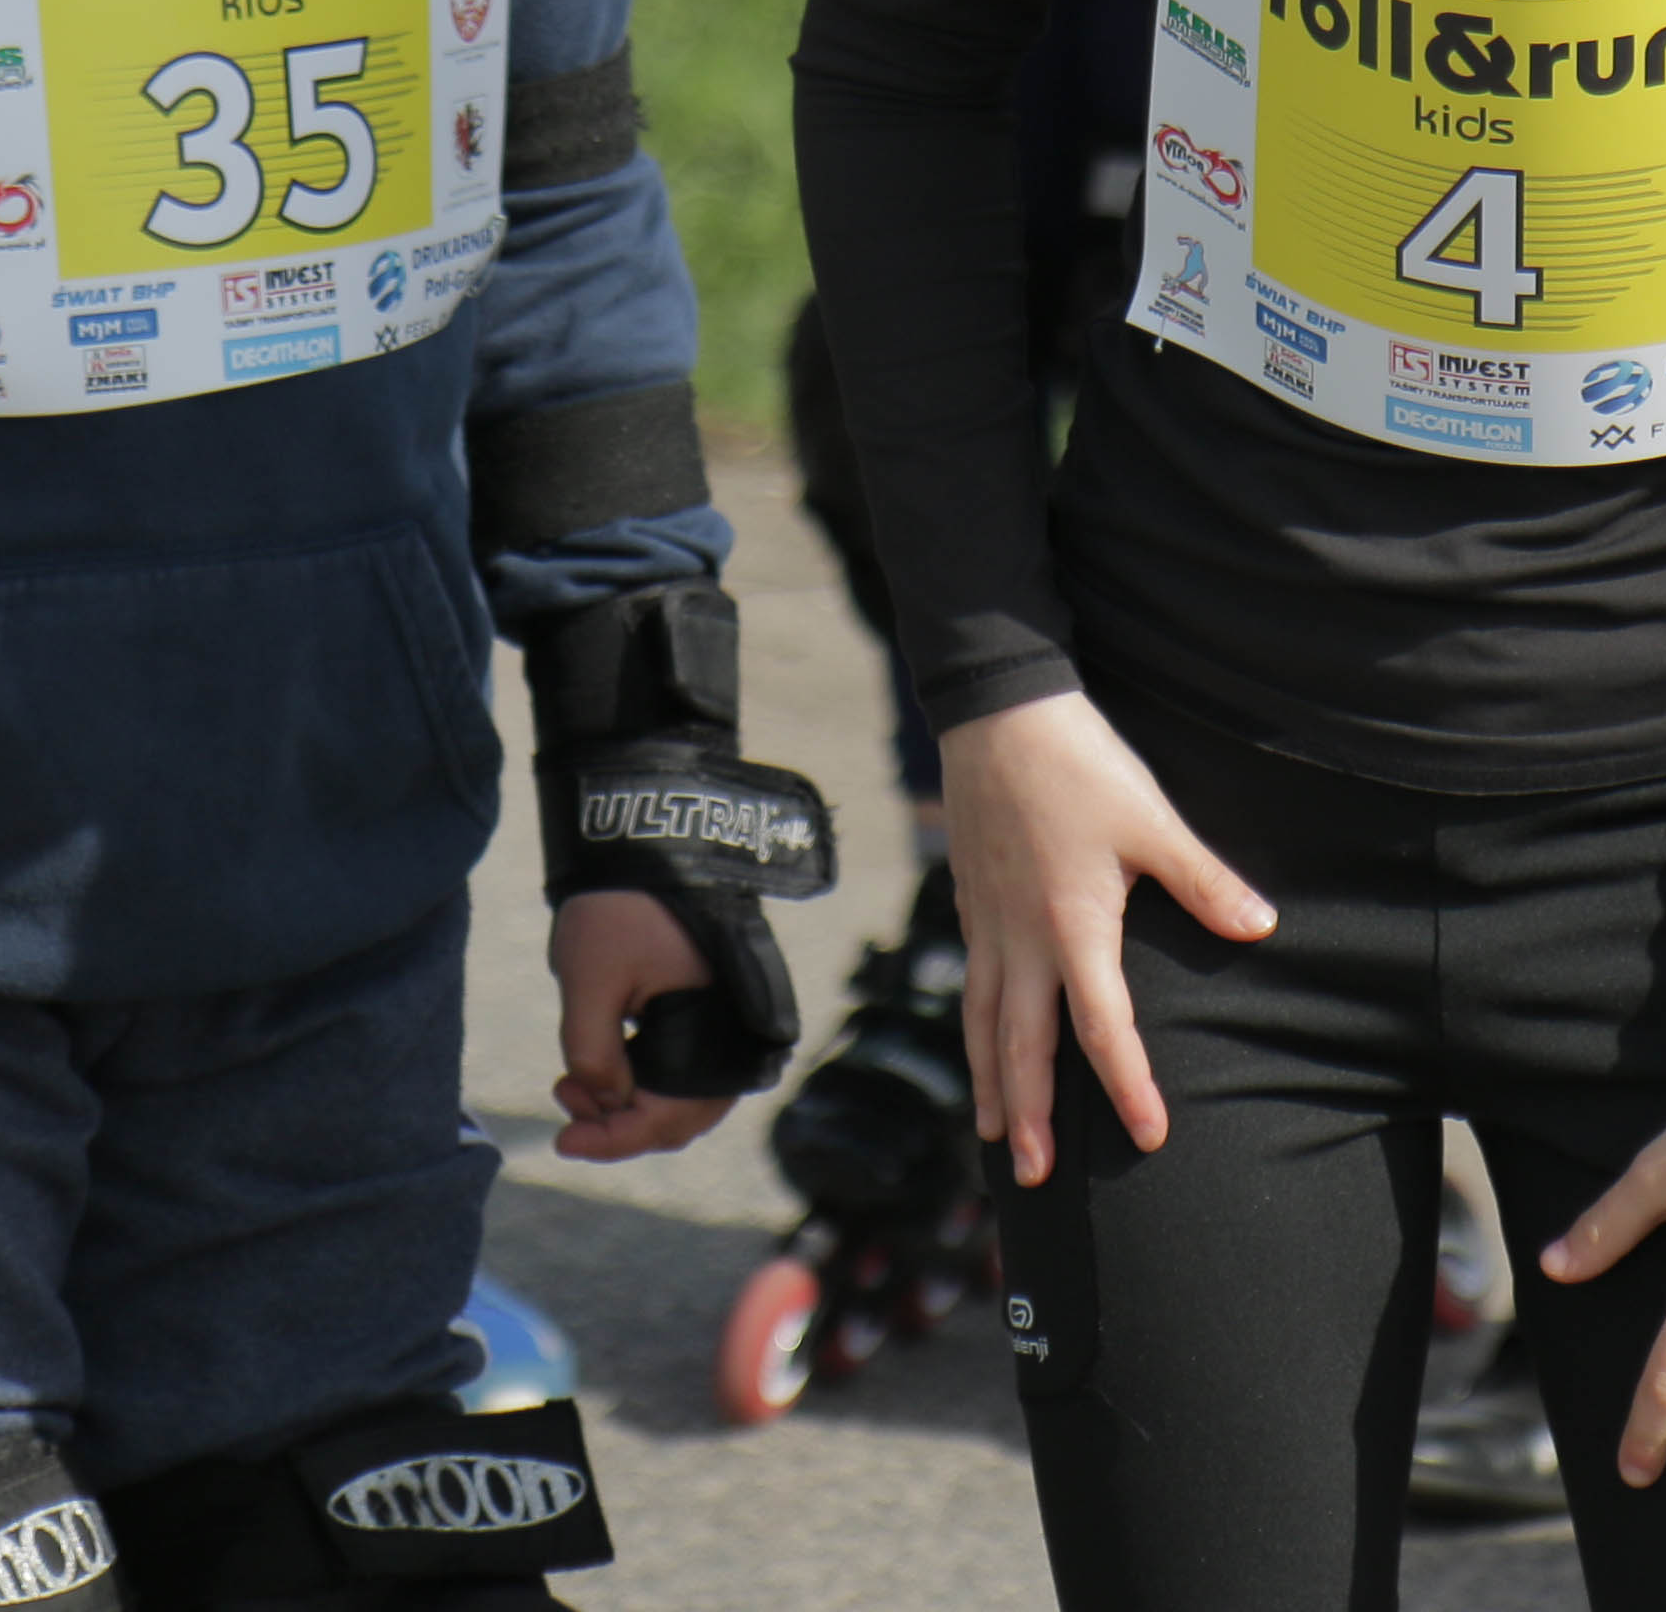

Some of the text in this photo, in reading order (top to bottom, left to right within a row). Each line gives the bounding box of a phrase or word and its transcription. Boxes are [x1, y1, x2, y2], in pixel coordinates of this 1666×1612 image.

[1415, 94, 1515, 145] kids
[141, 37, 377, 252] 35
[1396, 165, 1543, 332] 4
[265, 262, 336, 290] INVEST
[1245, 272, 1300, 316] ŚWIAT
[1306, 308, 1347, 336] BHP
[231, 336, 333, 369] DECATHLON
[1439, 354, 1531, 381] INVEST
[1438, 376, 1531, 396] SYSTEM
[1394, 405, 1523, 444] DECATHLON
[346, 1460, 575, 1530] moon
